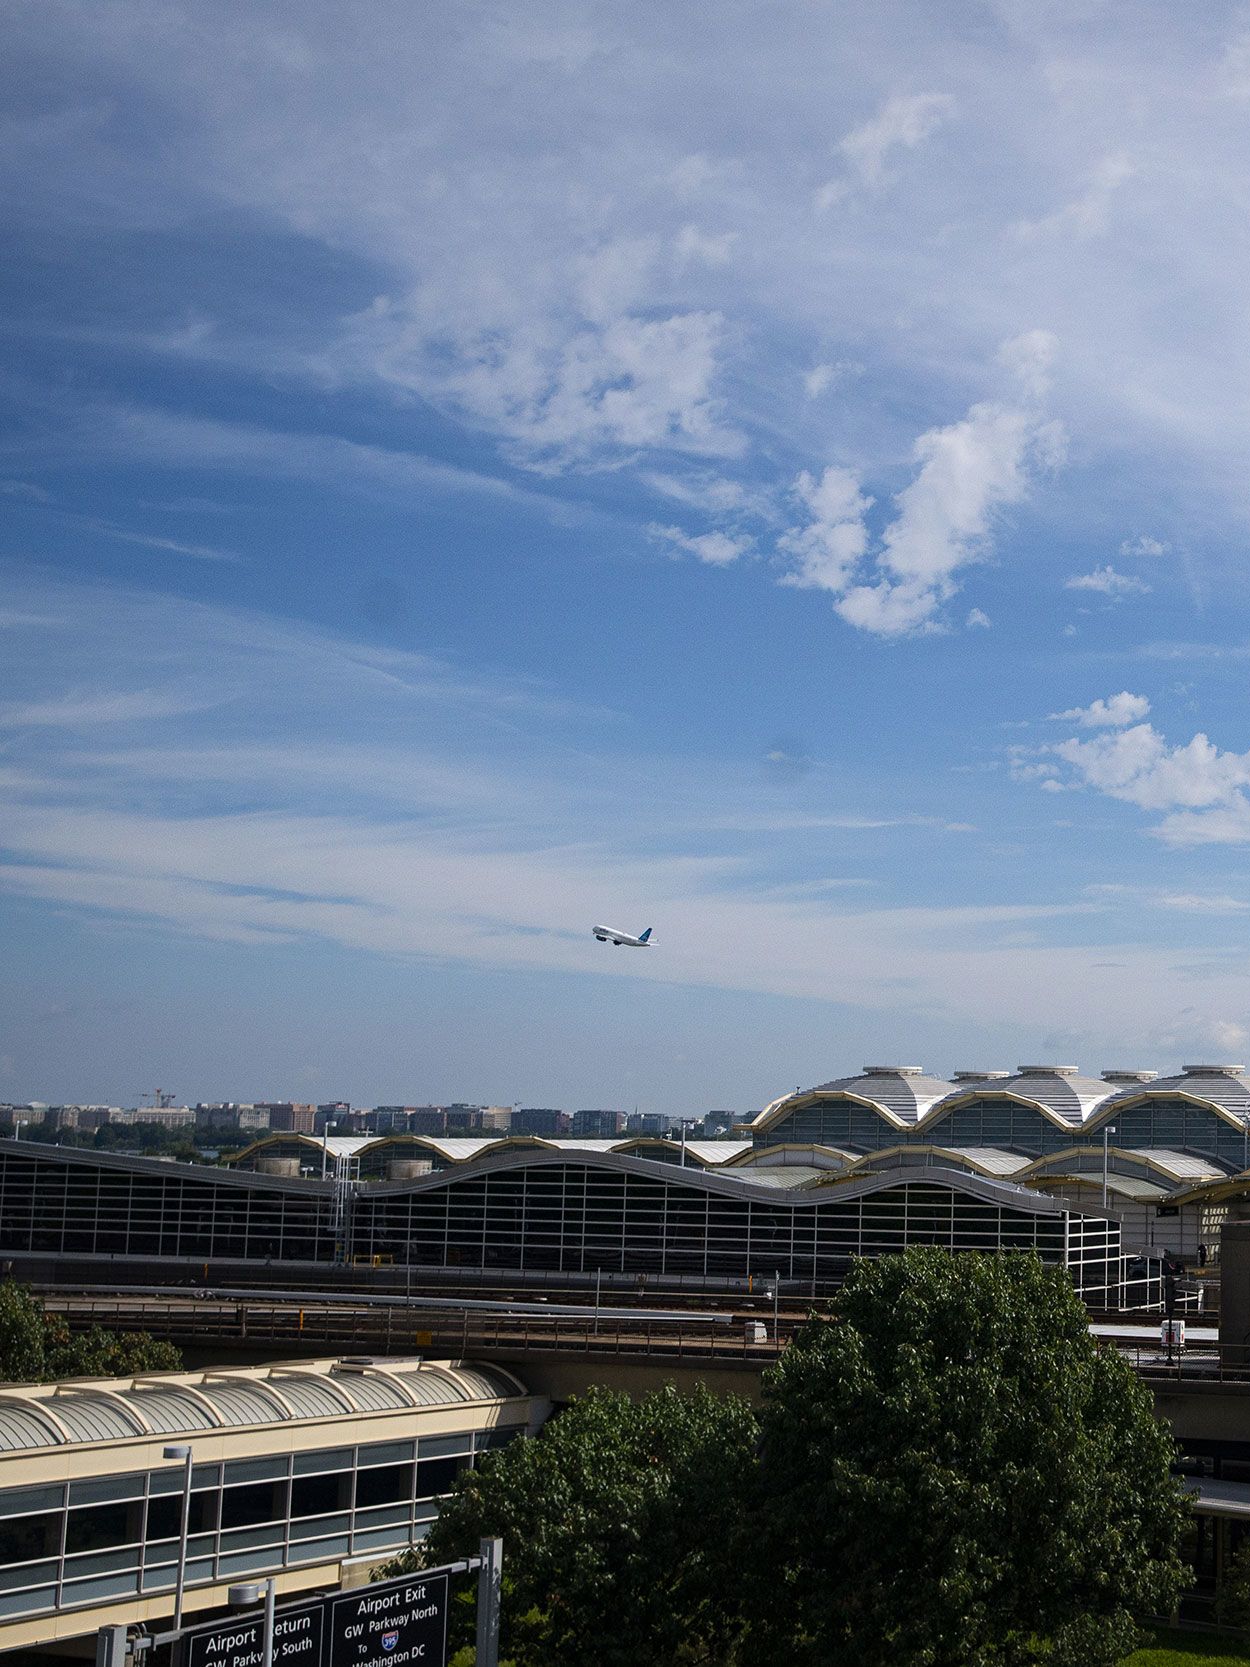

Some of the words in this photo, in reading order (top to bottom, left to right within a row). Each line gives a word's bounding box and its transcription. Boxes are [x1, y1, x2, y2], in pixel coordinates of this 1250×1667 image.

[357, 1592, 400, 1615] Airport
[405, 1585, 427, 1603] Exit
[205, 1628, 257, 1654] Airport
[272, 1616, 311, 1637] eturn
[344, 1623, 364, 1639] GW
[369, 1613, 409, 1633] Parkway
[411, 1604, 438, 1621] North
[233, 1647, 280, 1667] Parkwy
[282, 1636, 313, 1656] South
[358, 1644, 368, 1654] To
[384, 1636, 396, 1647] 395
[411, 1644, 426, 1659] DC
